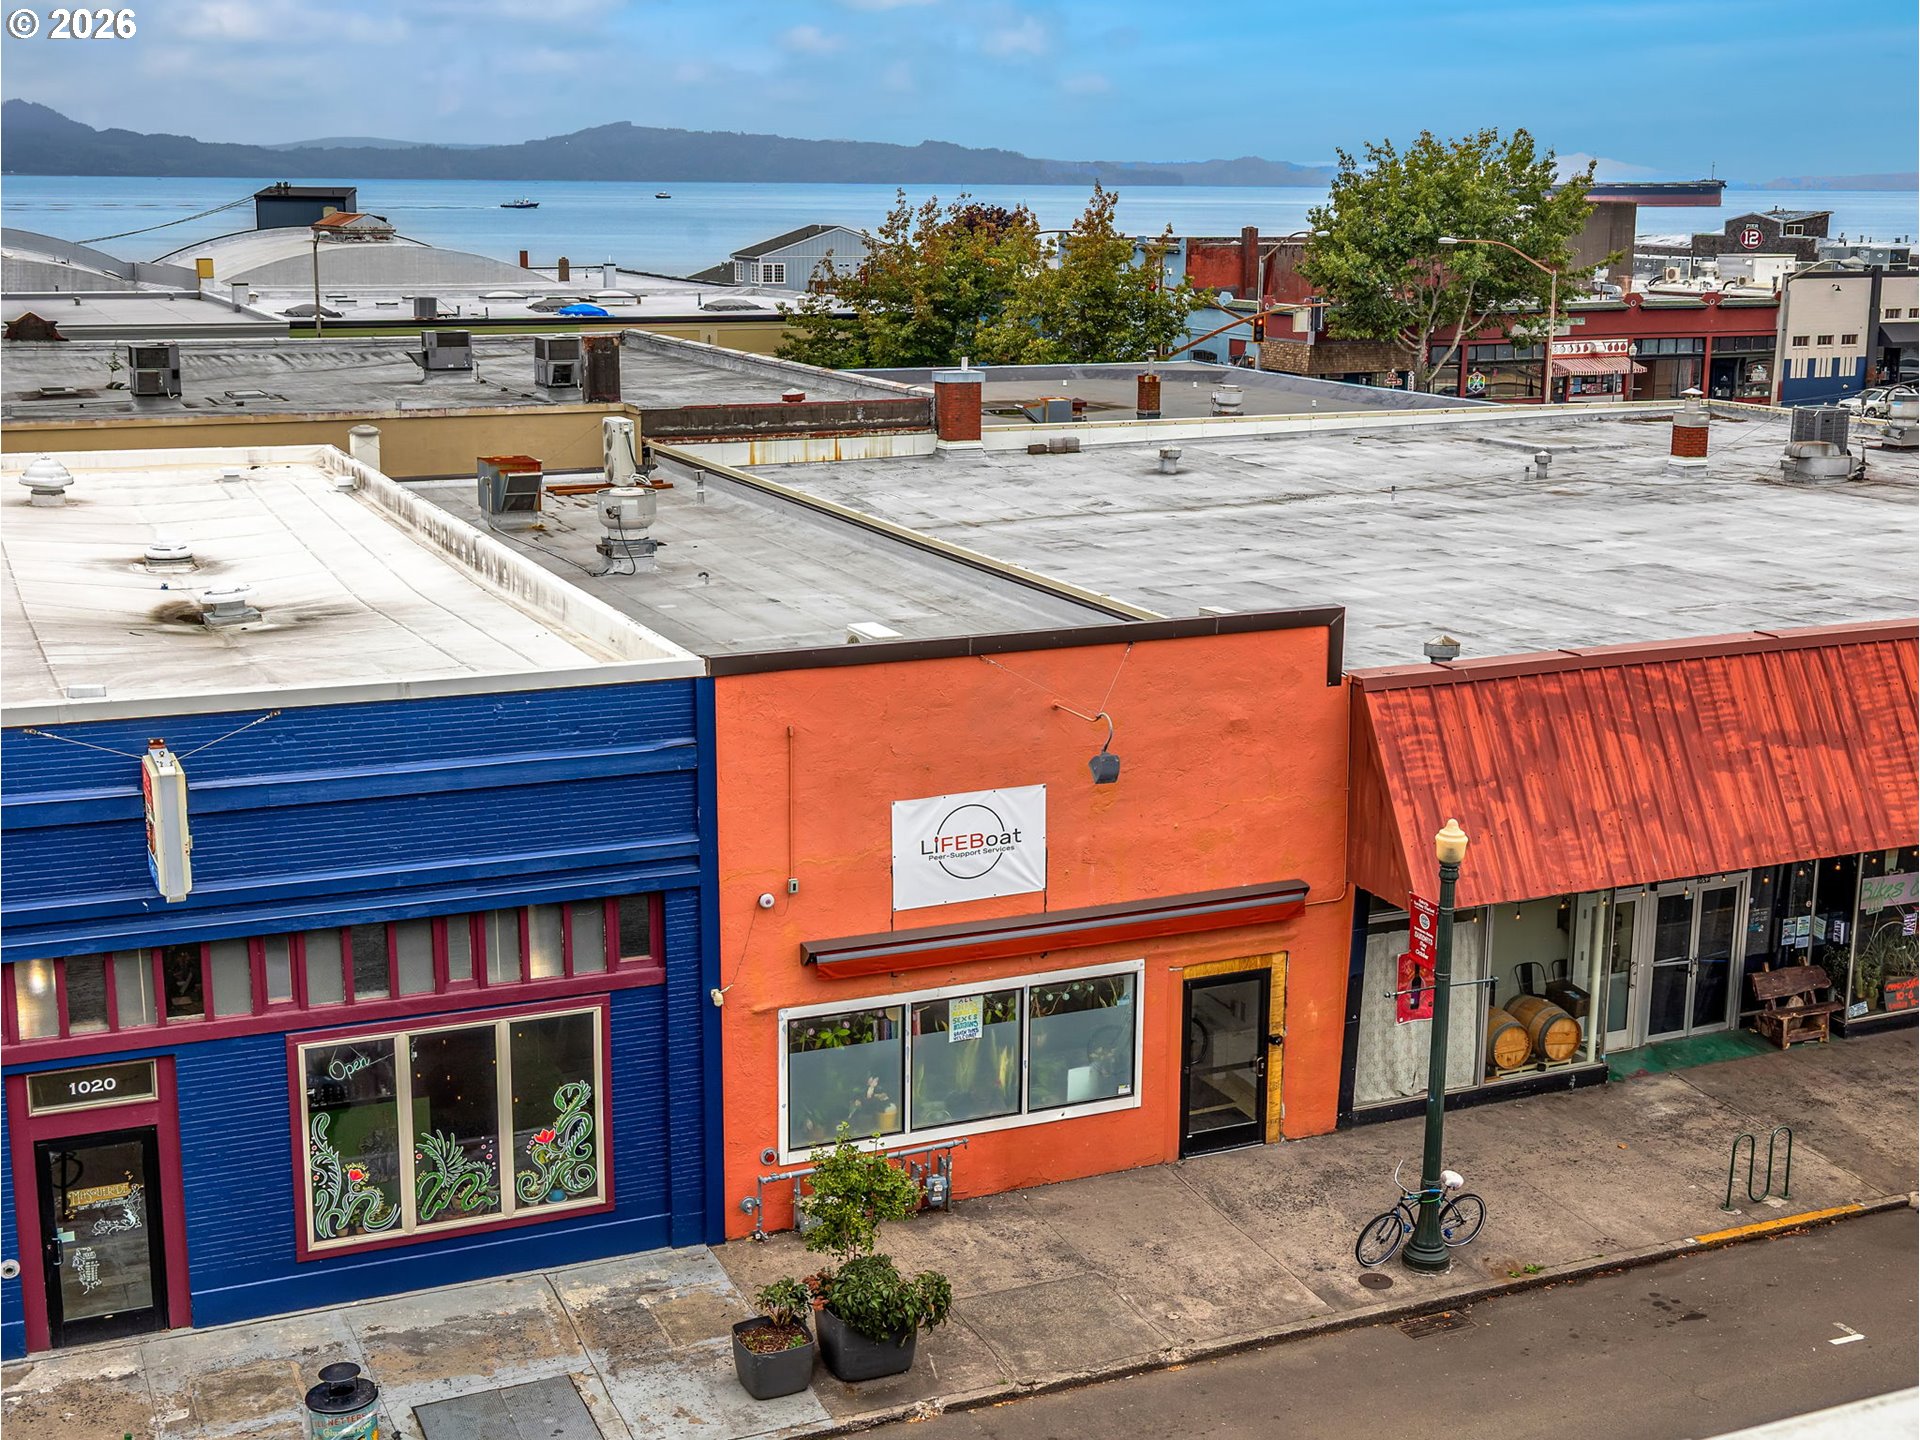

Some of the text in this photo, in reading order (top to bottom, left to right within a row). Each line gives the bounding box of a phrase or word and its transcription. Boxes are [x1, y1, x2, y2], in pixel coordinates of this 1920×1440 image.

[1743, 231, 1759, 245] 12
[928, 844, 1015, 862] Peer-Support Services
[1861, 880, 1905, 901] Bikes
[329, 1057, 371, 1080] Open
[68, 1077, 117, 1096] 1020
